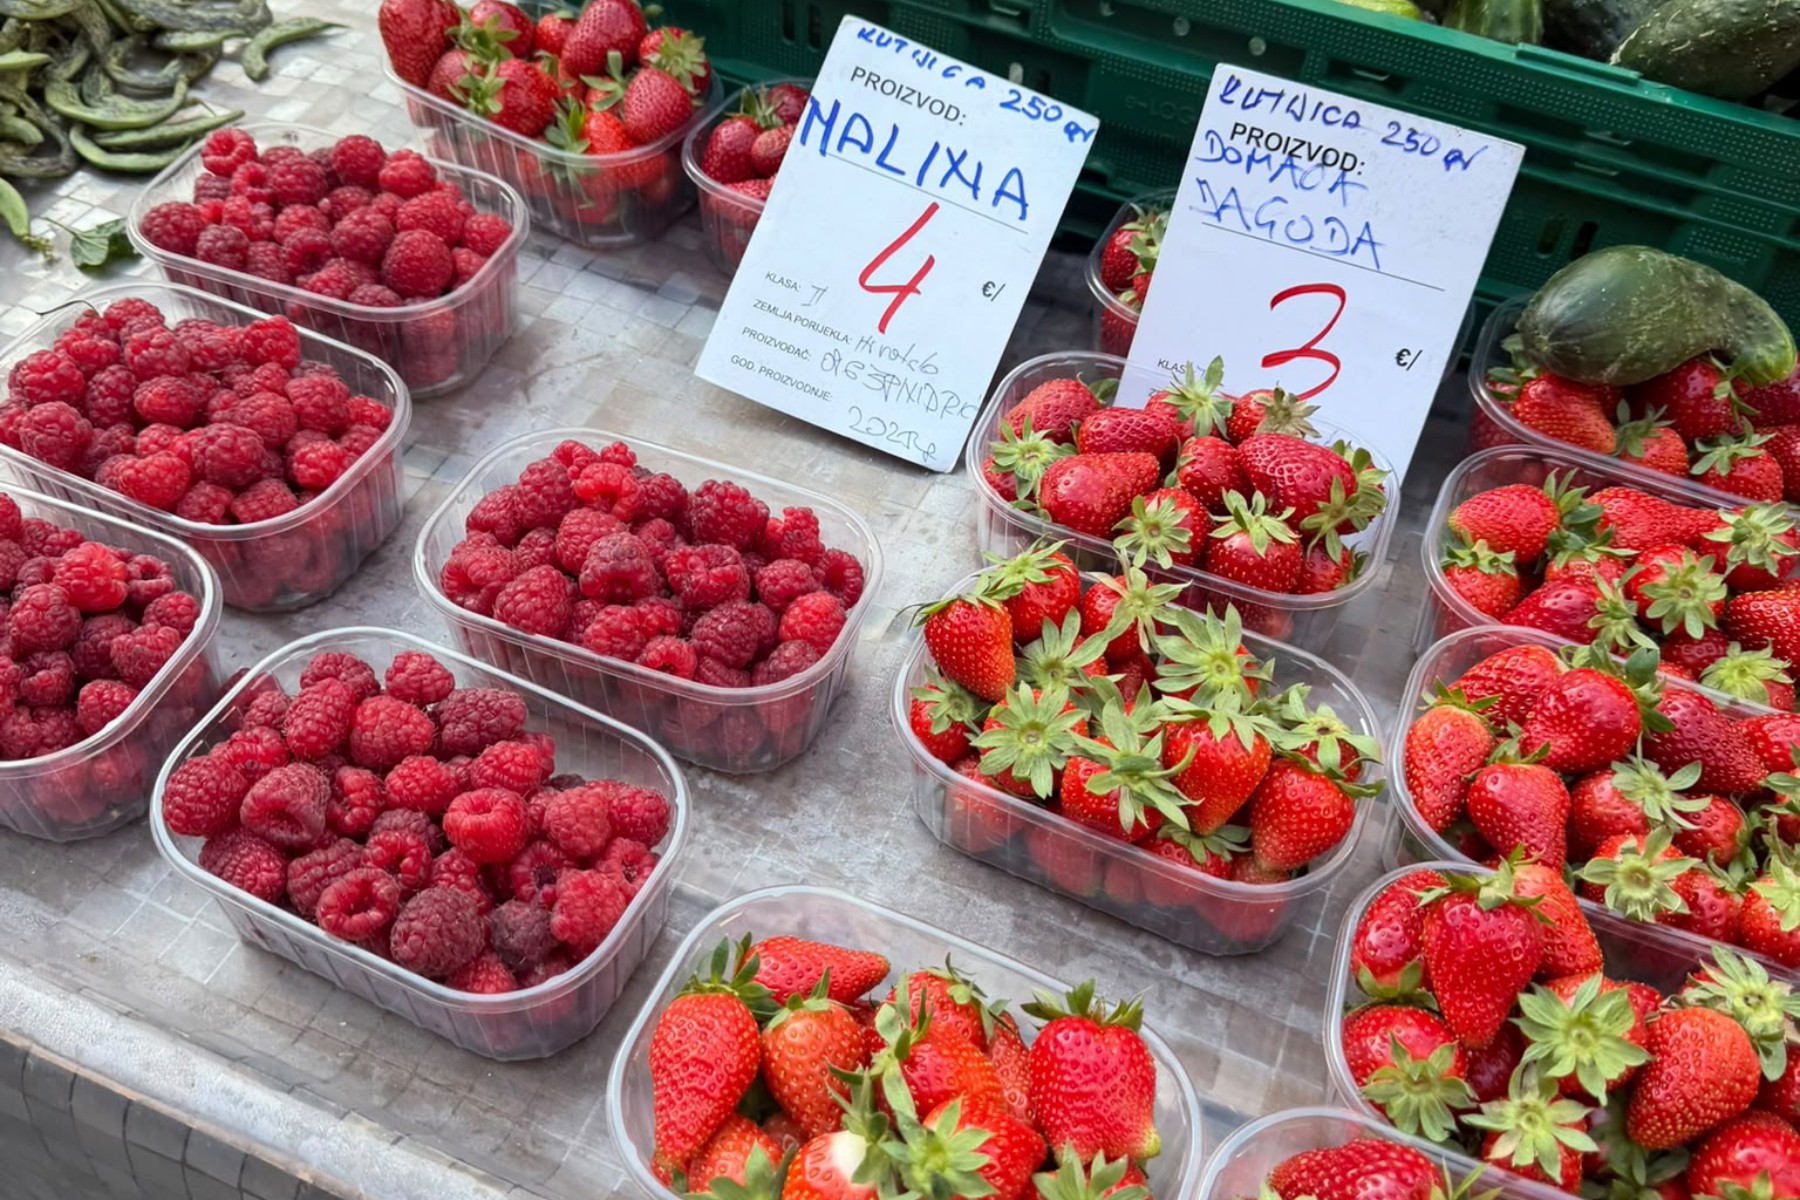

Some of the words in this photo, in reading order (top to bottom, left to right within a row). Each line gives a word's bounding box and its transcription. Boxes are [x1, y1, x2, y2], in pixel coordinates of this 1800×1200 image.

[850, 66, 967, 126] PROIZVOD:
[999, 89, 1063, 122] 250
[1230, 122, 1365, 176] PROIZVOD:
[1381, 121, 1440, 156] 250
[765, 271, 802, 292] KLASA:
[857, 201, 940, 335] 4
[753, 299, 793, 323] ZEMLJA
[793, 315, 853, 345] PORIJEKLA:
[1218, 283, 1346, 401] 3
[731, 354, 757, 373] GOD.
[758, 366, 833, 402] PROIZVODNJE:
